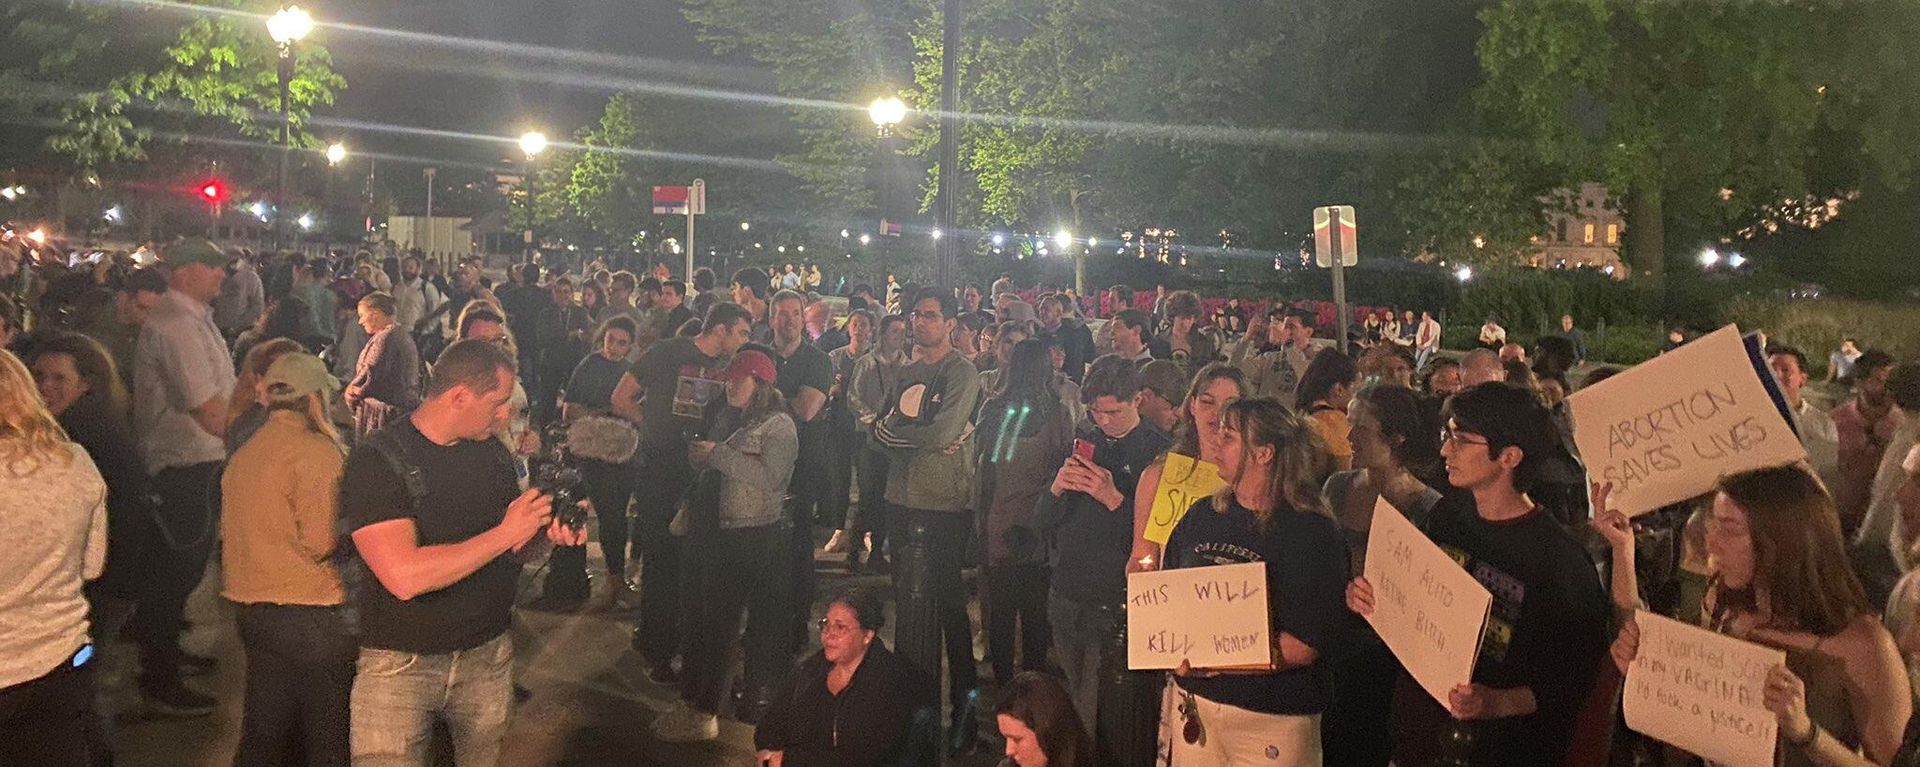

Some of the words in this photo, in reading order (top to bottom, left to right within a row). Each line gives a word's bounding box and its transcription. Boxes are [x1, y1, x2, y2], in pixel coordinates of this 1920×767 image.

[1607, 383, 1737, 458] ABORTION
[1603, 444, 1682, 494] SAVES
[1691, 416, 1767, 460] LIVES
[1386, 529, 1413, 572] SAM
[1419, 567, 1454, 608] ALITO
[1131, 583, 1169, 607] THIS
[1194, 580, 1260, 602] WILL
[1148, 630, 1196, 655] KILL
[1212, 632, 1259, 655] WOMEN
[1673, 667, 1751, 707] VAGINA
[1691, 703, 1701, 716] a
